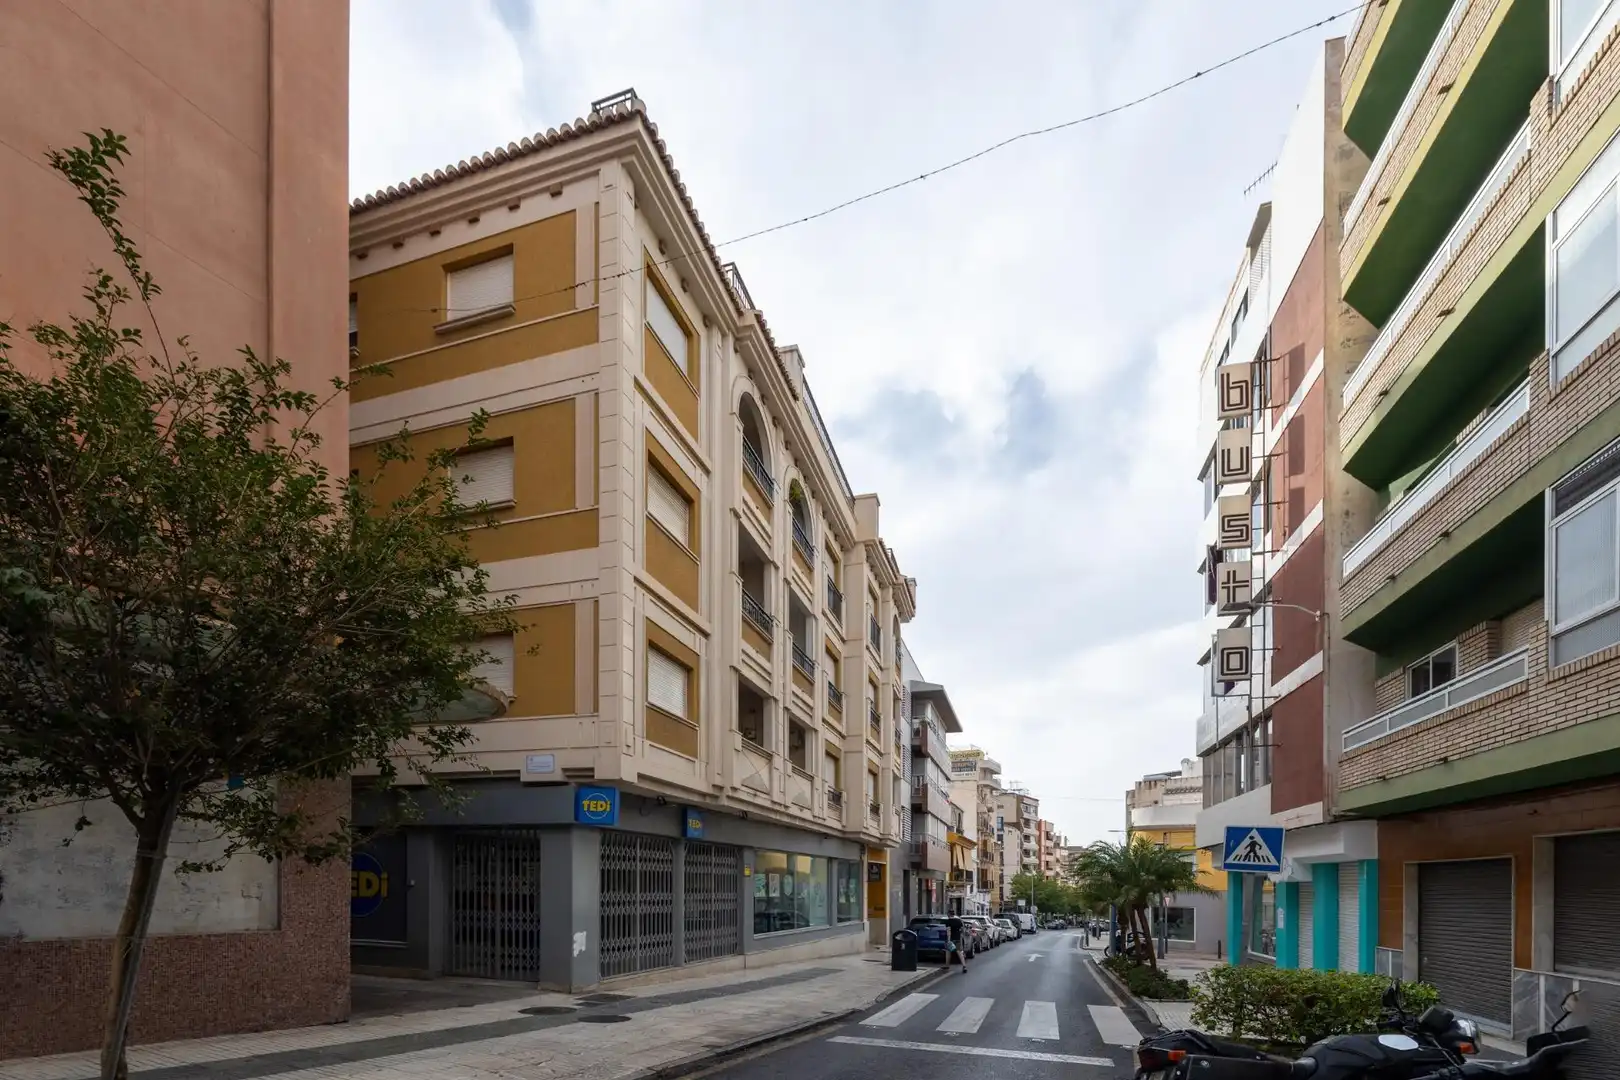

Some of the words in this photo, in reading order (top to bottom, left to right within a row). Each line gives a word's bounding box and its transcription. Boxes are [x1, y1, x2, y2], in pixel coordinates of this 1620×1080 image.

[1221, 372, 1250, 676] busto
[582, 800, 611, 811] TEDi
[351, 871, 388, 897] EDi
